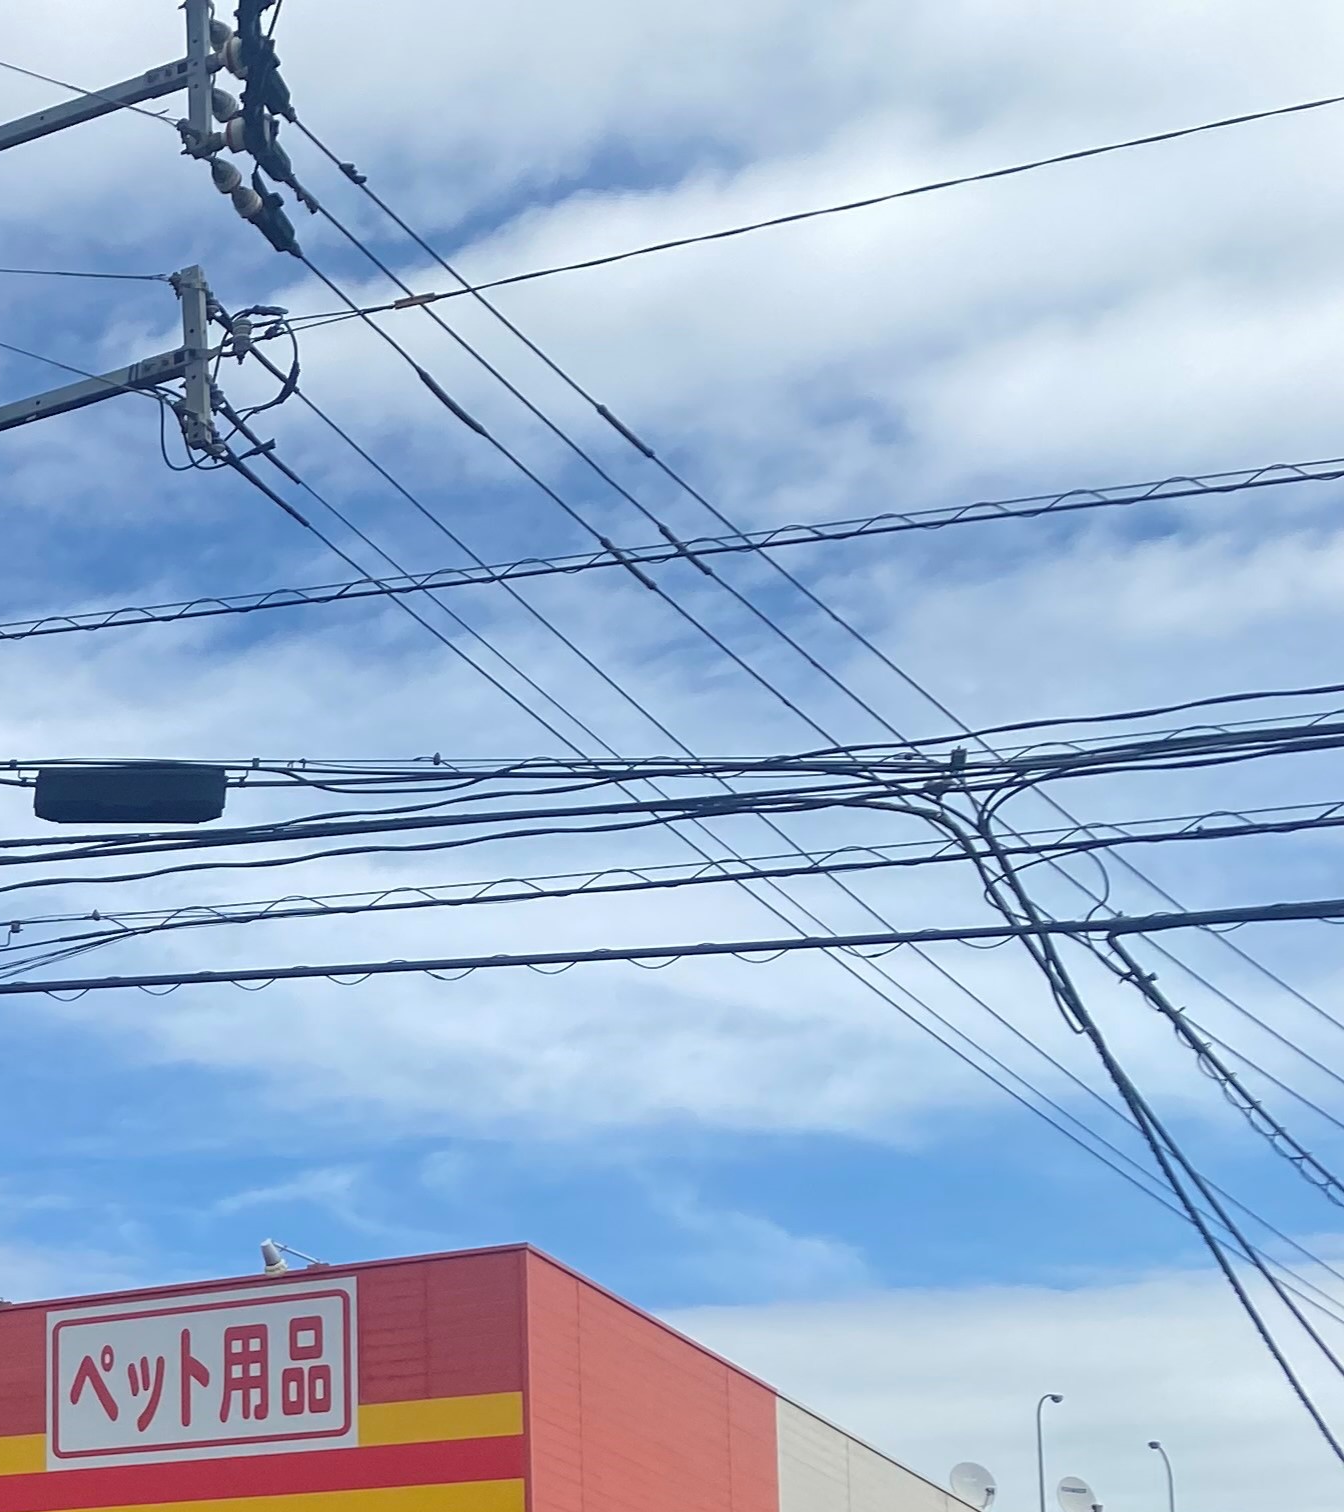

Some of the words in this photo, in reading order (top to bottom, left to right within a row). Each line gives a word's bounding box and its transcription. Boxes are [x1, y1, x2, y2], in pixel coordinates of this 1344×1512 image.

[69, 1314, 332, 1433] ペット用品
